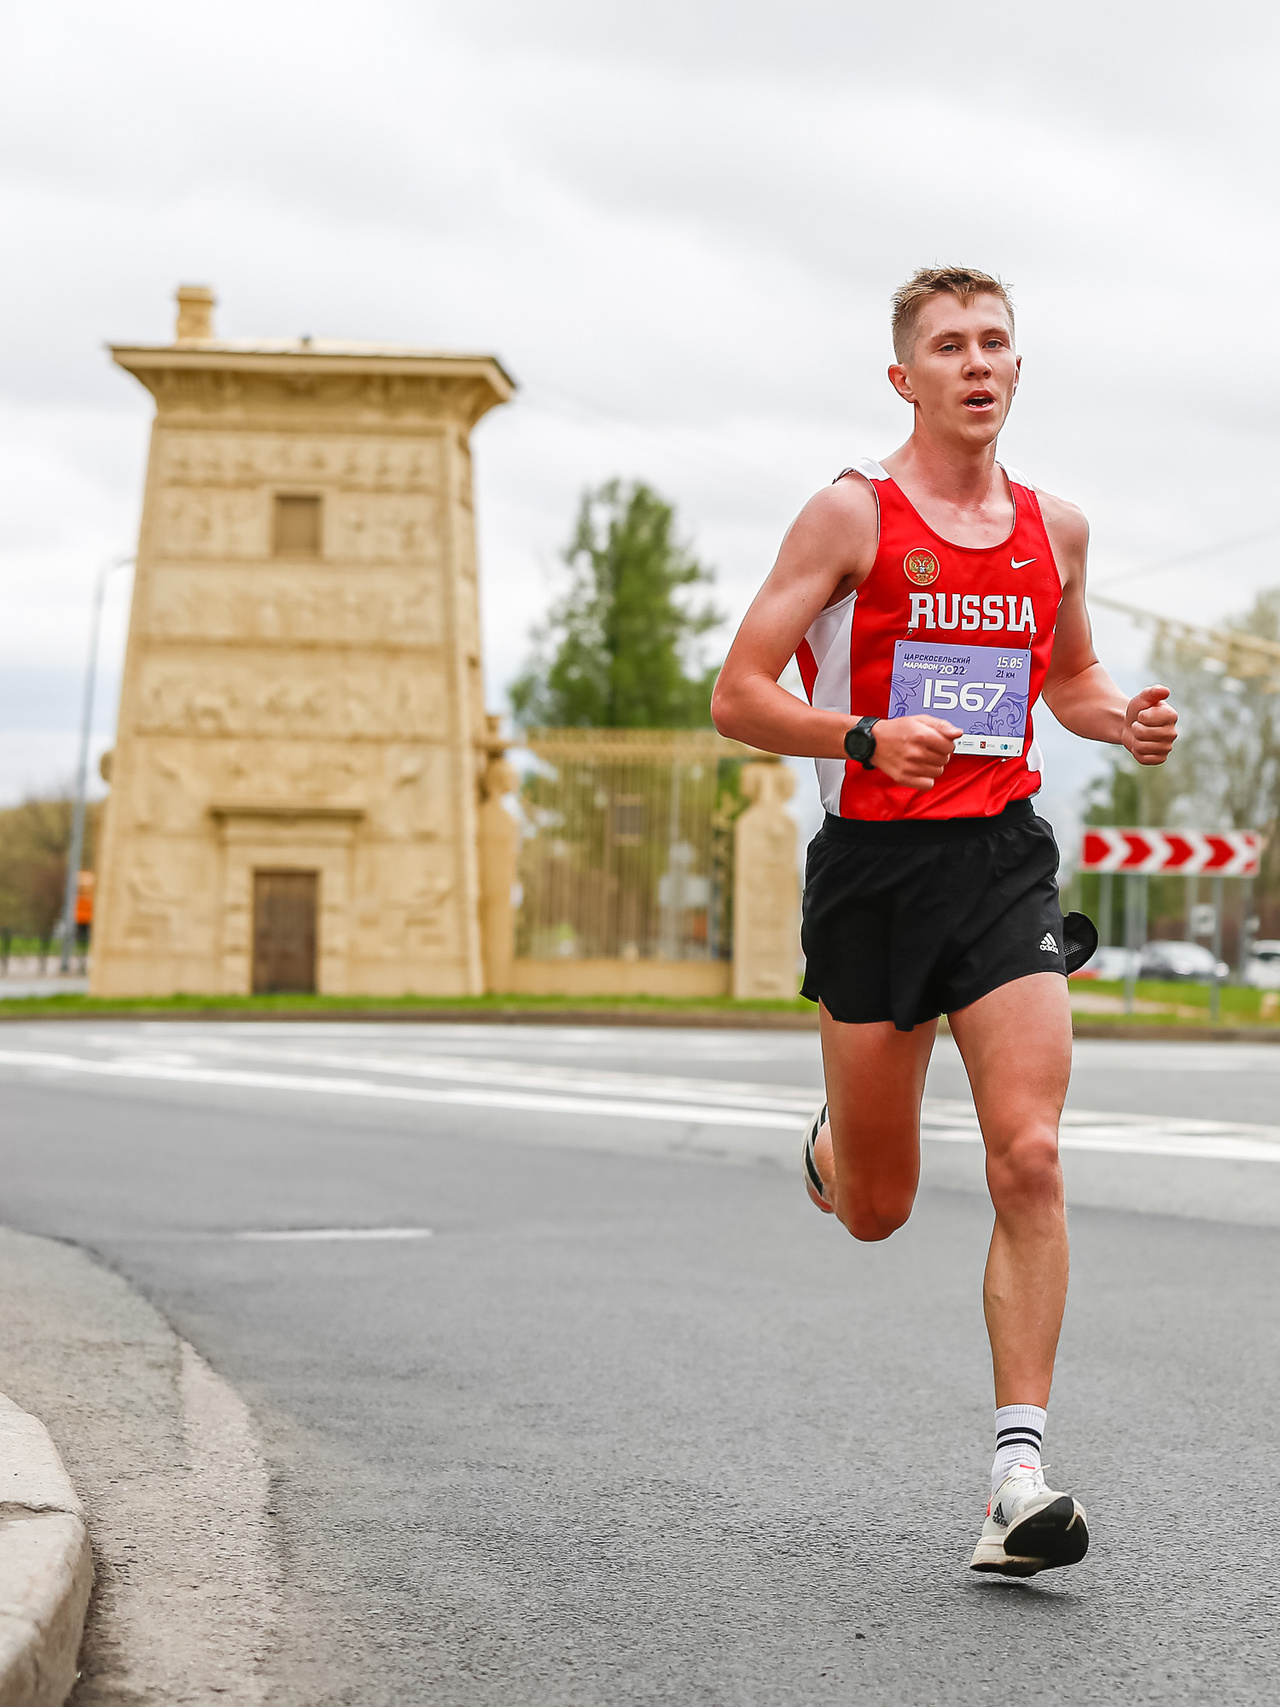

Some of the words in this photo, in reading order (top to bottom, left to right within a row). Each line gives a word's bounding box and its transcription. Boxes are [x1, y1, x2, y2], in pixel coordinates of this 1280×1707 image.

[908, 592, 1037, 633] RUSSIA
[904, 653, 971, 664] ЦАРСКОСЕЛЬСКИЙ
[996, 656, 1023, 669] 15.05
[903, 661, 938, 671] МАРАФОН
[938, 665, 967, 675] 2022
[996, 670, 1004, 678] 21
[922, 678, 1007, 713] 1567
[1040, 944, 1059, 954] adida
